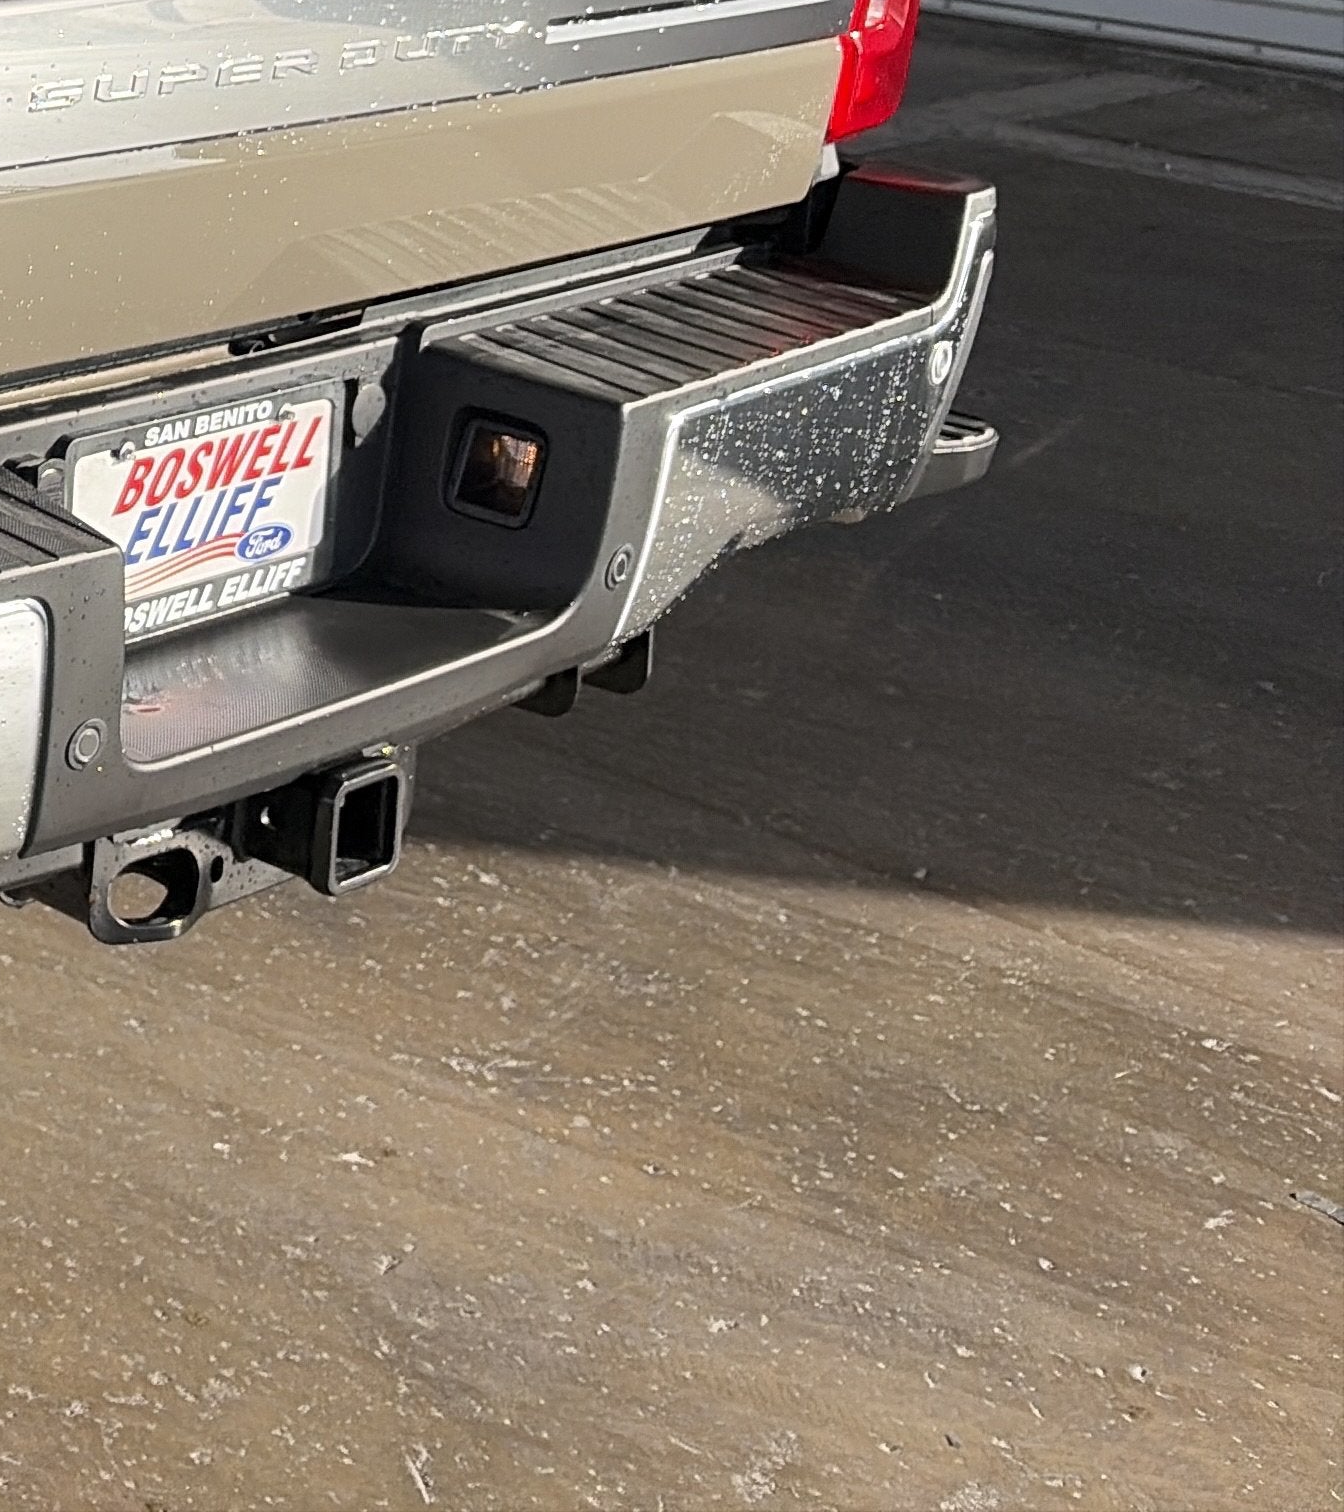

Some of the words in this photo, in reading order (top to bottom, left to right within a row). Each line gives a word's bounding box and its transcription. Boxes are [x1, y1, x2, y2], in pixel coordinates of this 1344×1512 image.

[28, 49, 317, 112] SUPER
[339, 19, 526, 76] DUTY
[112, 415, 323, 516] BOSWELL
[144, 417, 191, 448] SAN
[194, 400, 273, 437] BENITO
[125, 475, 284, 566] ELLIFF
[245, 529, 283, 559] Ford
[124, 583, 214, 633] SWELL
[216, 556, 307, 608] ELLIFF
